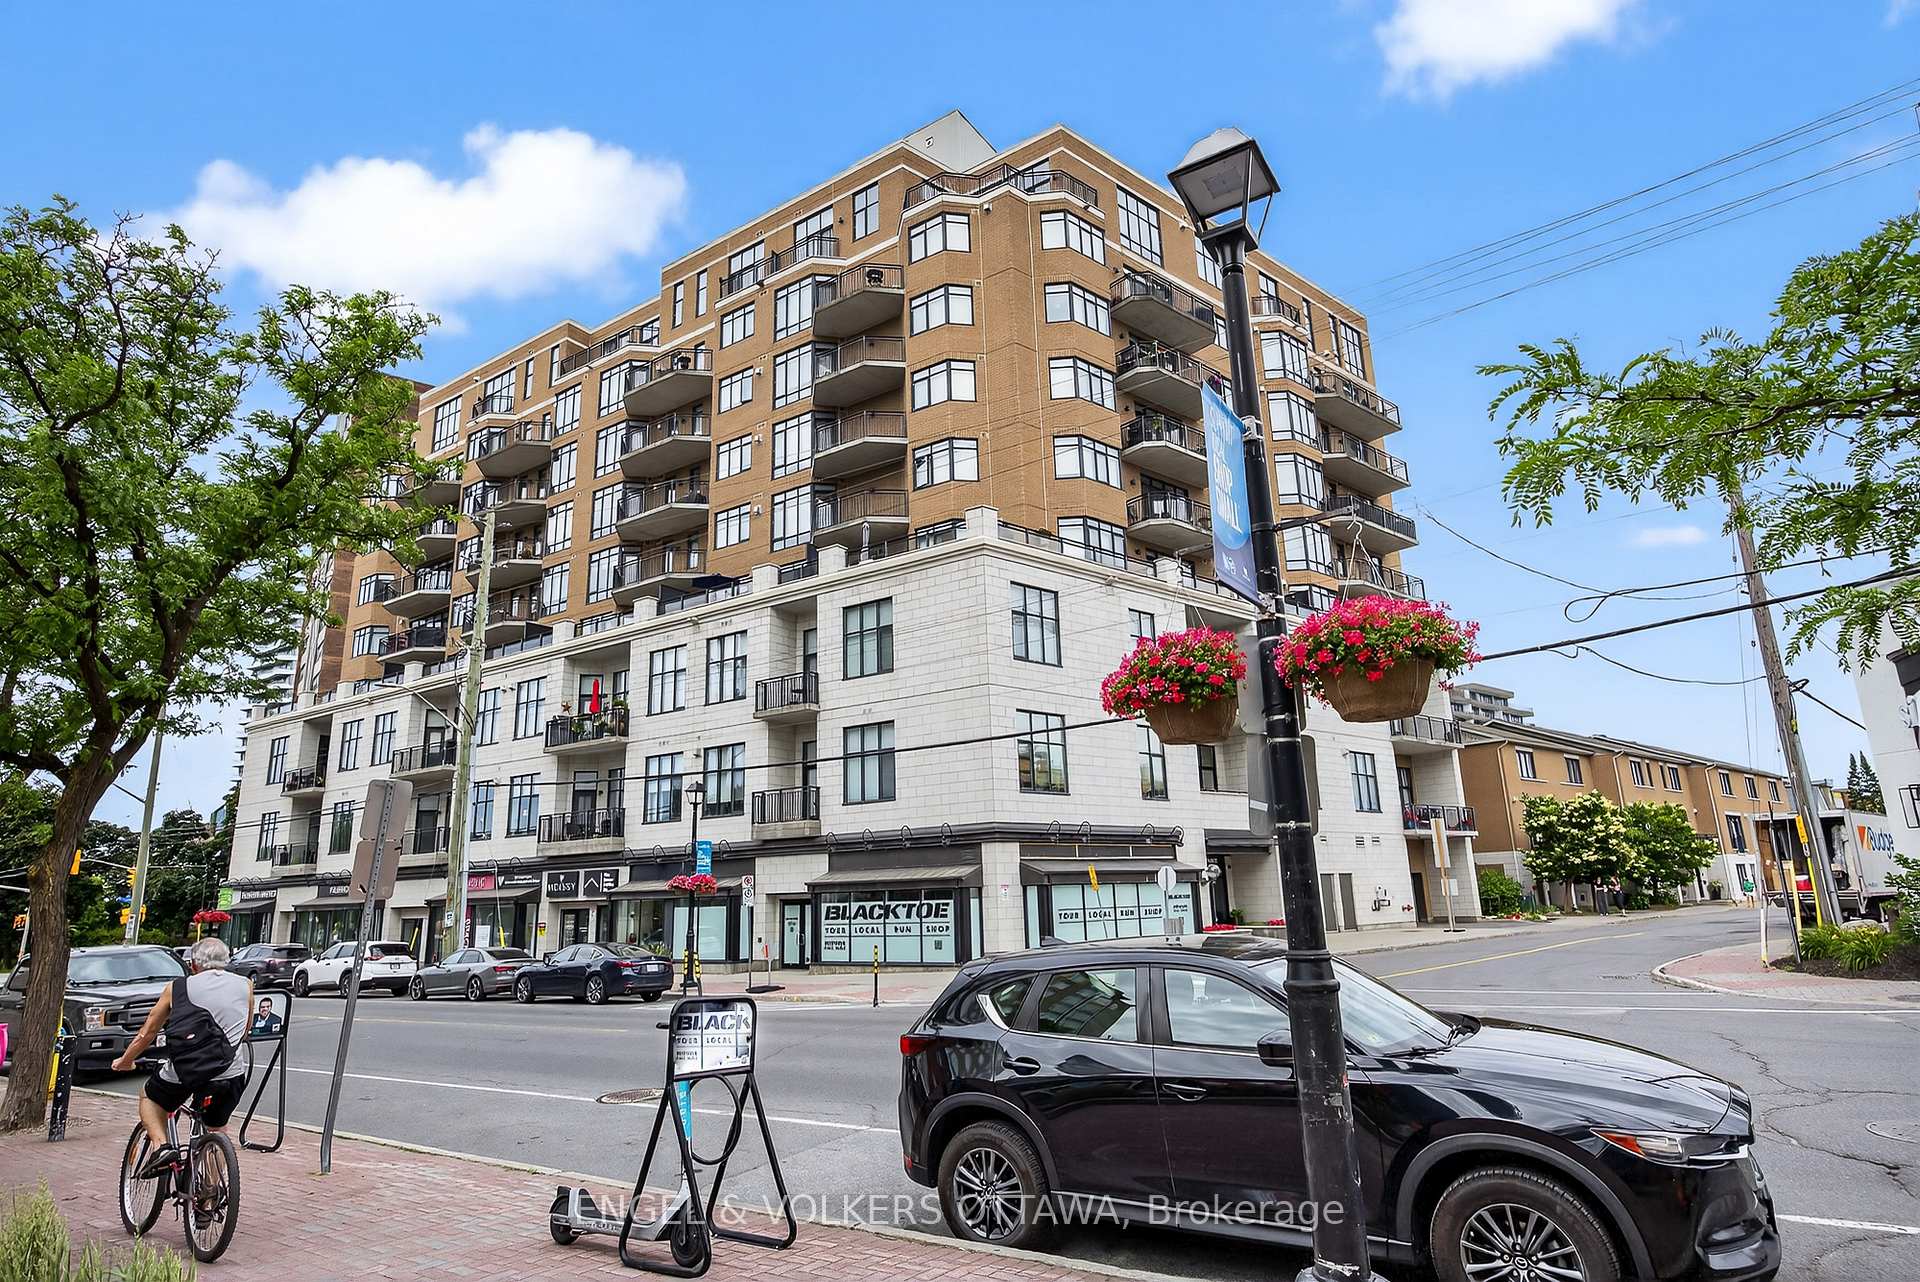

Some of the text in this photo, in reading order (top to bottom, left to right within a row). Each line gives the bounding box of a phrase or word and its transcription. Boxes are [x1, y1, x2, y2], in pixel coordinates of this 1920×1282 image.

[824, 902, 950, 921] BLACKTOE
[1088, 910, 1111, 918] LOCAL
[855, 926, 880, 934] LOCAL
[677, 1014, 751, 1031] BLACK
